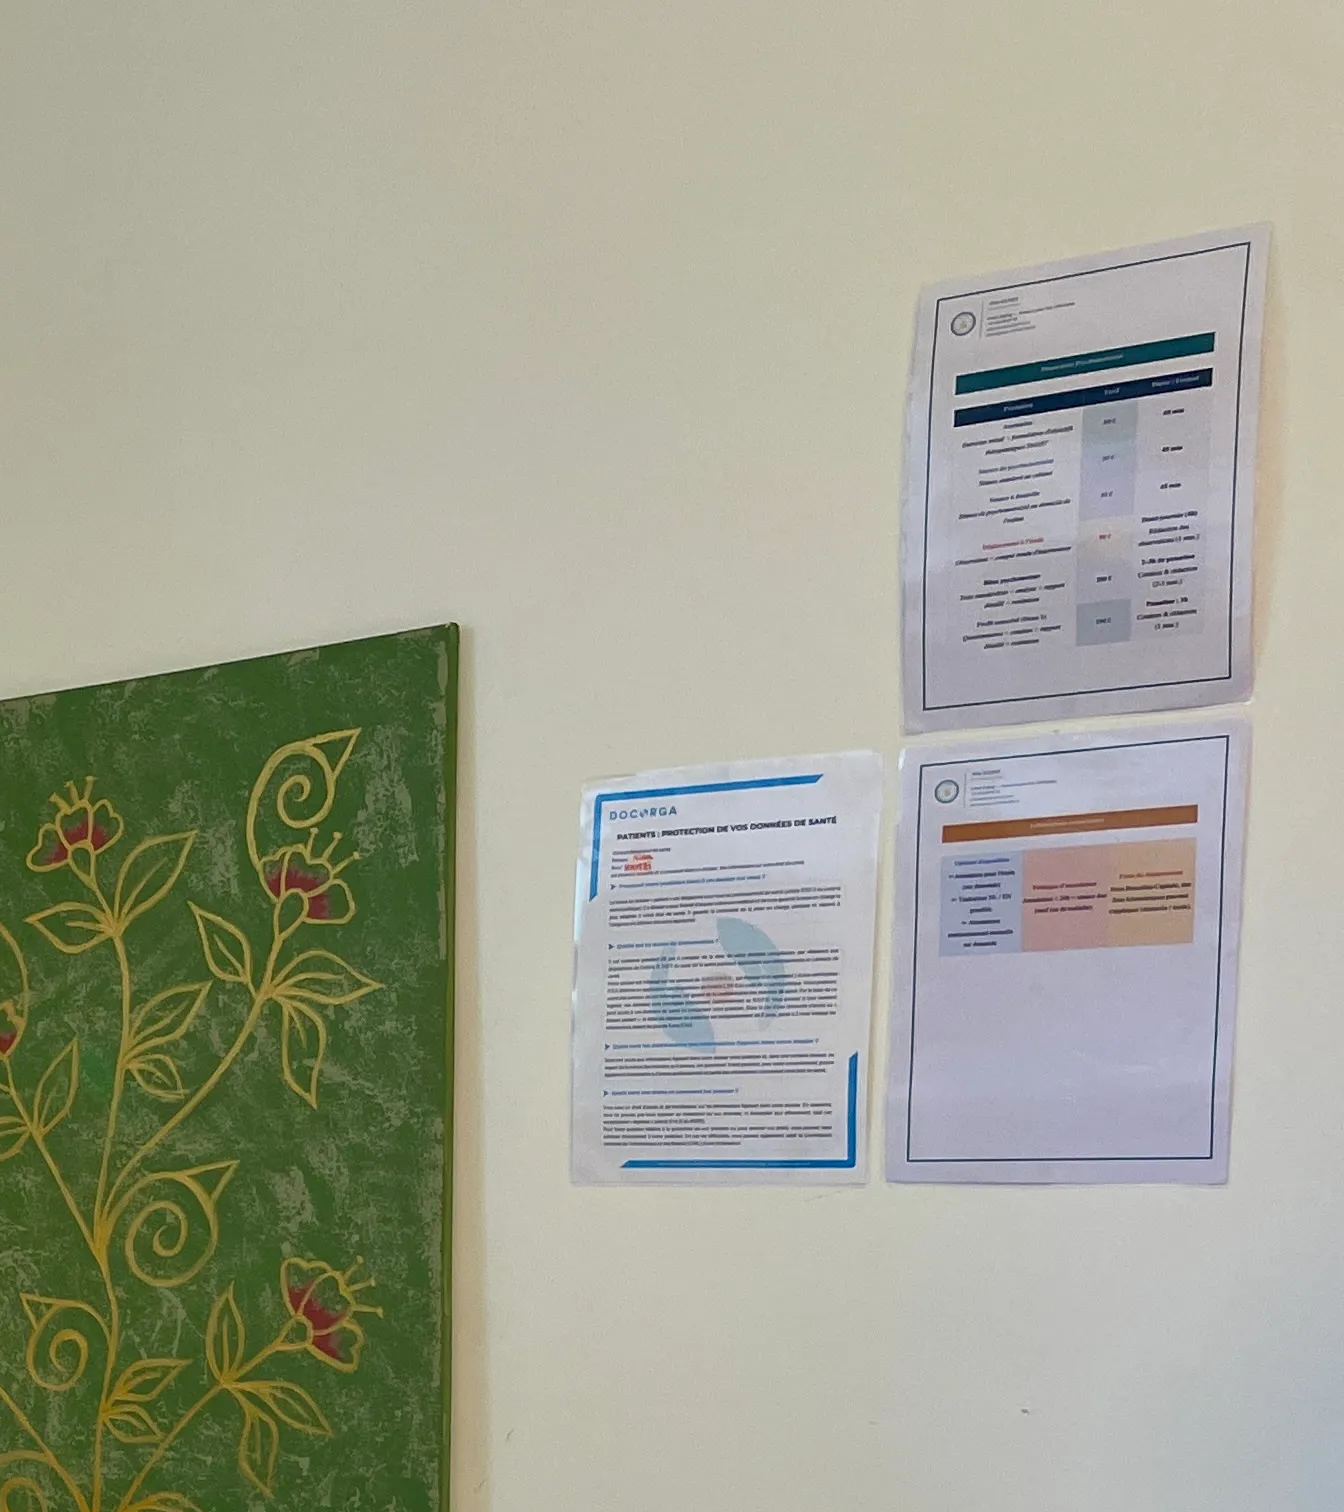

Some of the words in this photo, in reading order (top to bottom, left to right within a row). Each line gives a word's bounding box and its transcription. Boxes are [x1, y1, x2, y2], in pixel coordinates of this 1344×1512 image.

[662, 827, 714, 837] PROTECTION
[730, 824, 748, 832] VOS
[808, 816, 836, 825] SANTÉ
